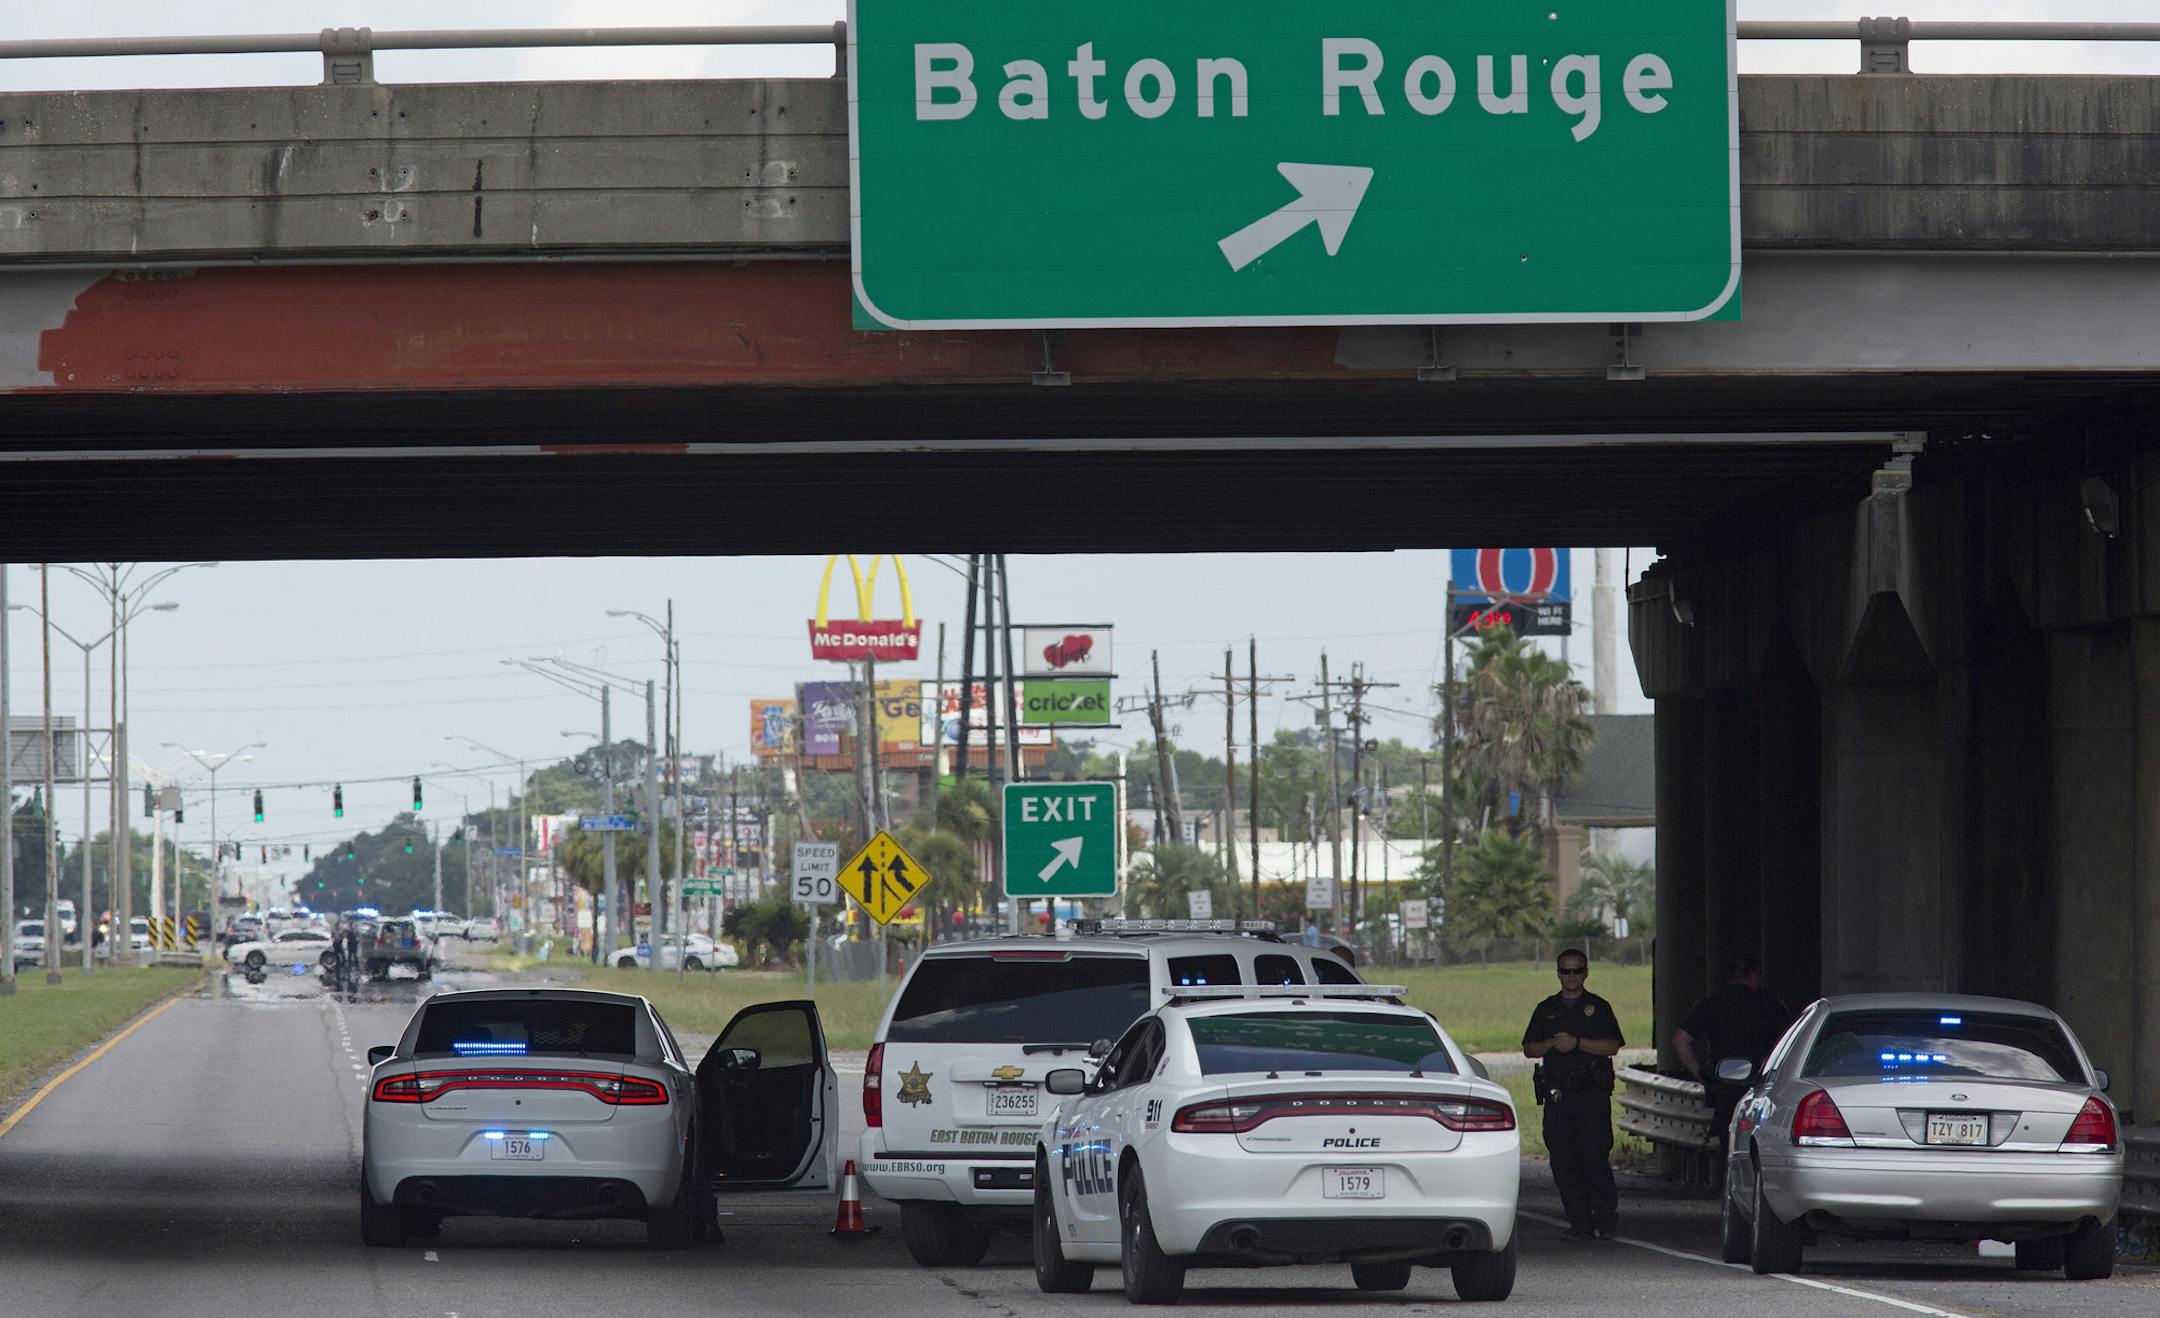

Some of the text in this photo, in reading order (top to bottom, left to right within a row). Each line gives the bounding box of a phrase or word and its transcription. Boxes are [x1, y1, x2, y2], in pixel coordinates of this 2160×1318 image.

[914, 37, 1674, 143] Baton Rouge
[813, 632, 918, 647] McDonald's
[1028, 692, 1106, 712] cricket
[1021, 796, 1097, 822] EXIT
[797, 847, 835, 858] SPEED
[800, 862, 831, 872] LIMIT
[797, 876, 832, 897] 50
[995, 1095, 1035, 1109] 236255
[1145, 1099, 1163, 1122] 911
[930, 1129, 1040, 1146] EAST BATON ROUGE
[1931, 1122, 1983, 1138] TZY 817
[504, 1140, 531, 1154] 1576
[1322, 1137, 1381, 1148] POLICE
[862, 1161, 946, 1175] www.EBRSO.org
[1061, 1138, 1114, 1198] POLICE
[1340, 1176, 1371, 1192] 1579
